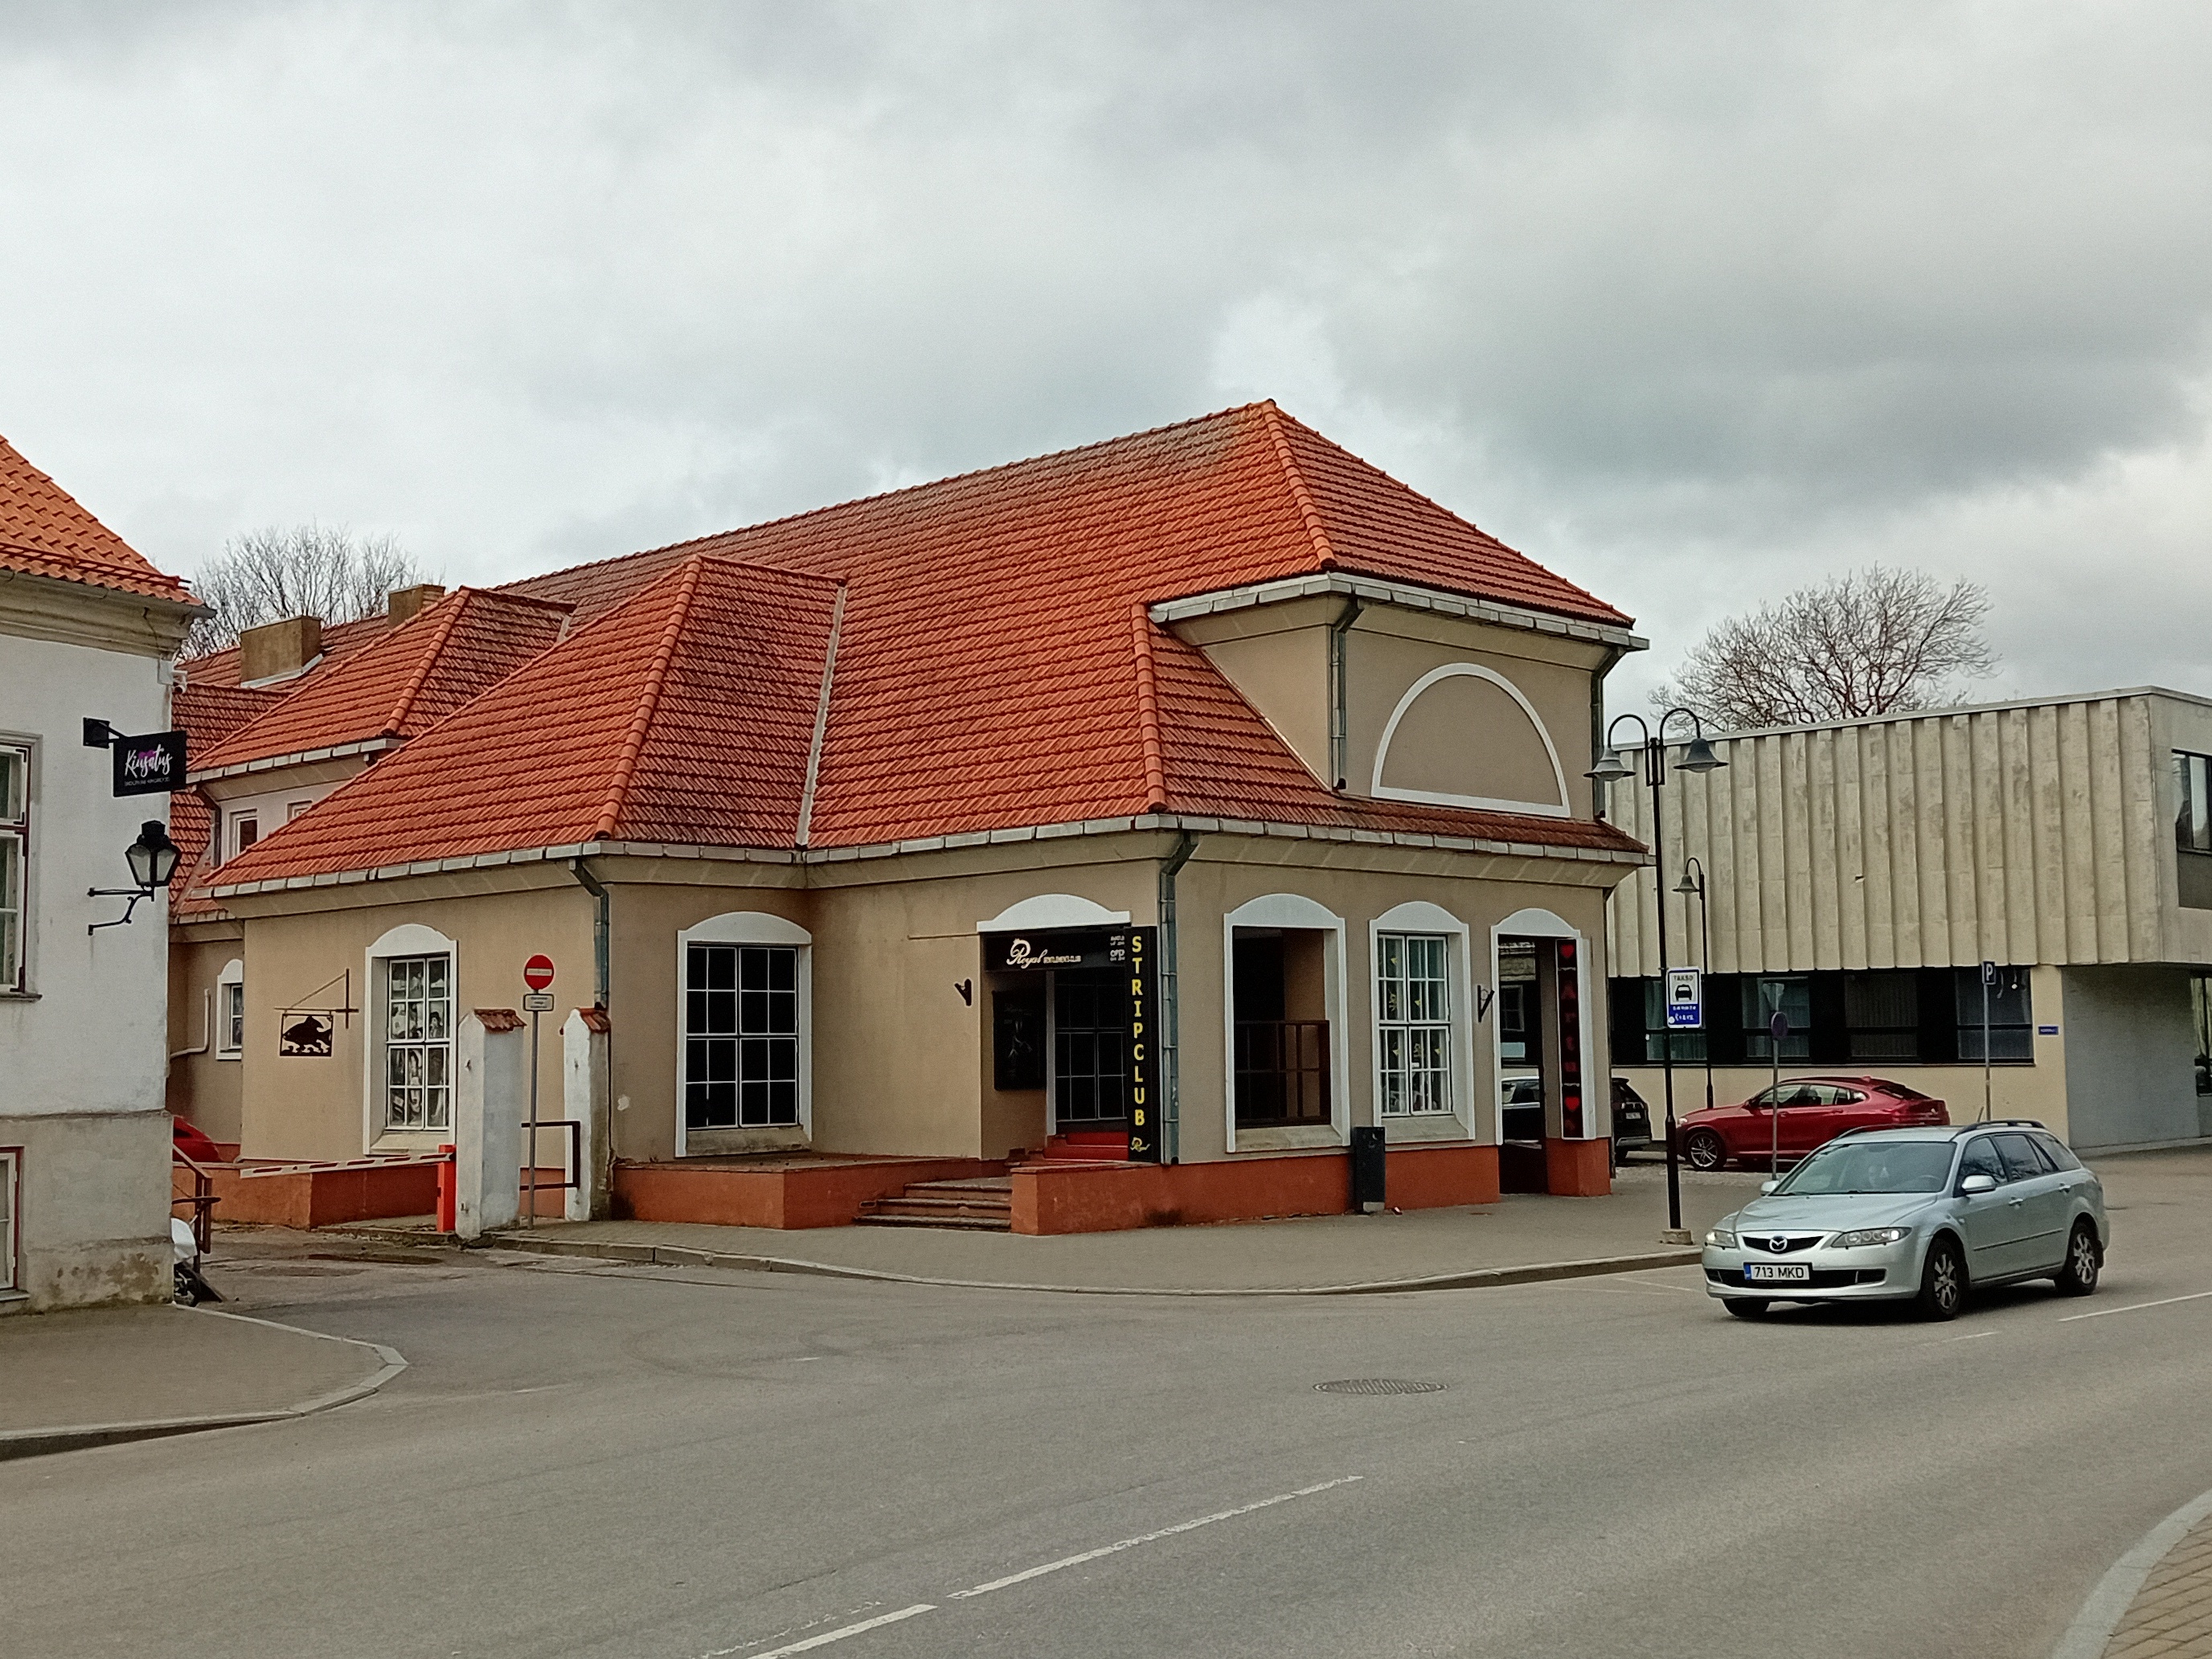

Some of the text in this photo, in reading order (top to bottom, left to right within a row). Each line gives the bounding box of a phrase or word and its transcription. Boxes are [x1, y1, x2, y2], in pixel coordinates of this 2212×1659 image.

[1006, 938, 1048, 969] Royal
[1985, 964, 1993, 981] P
[1755, 1266, 1804, 1278] 713 MKD
